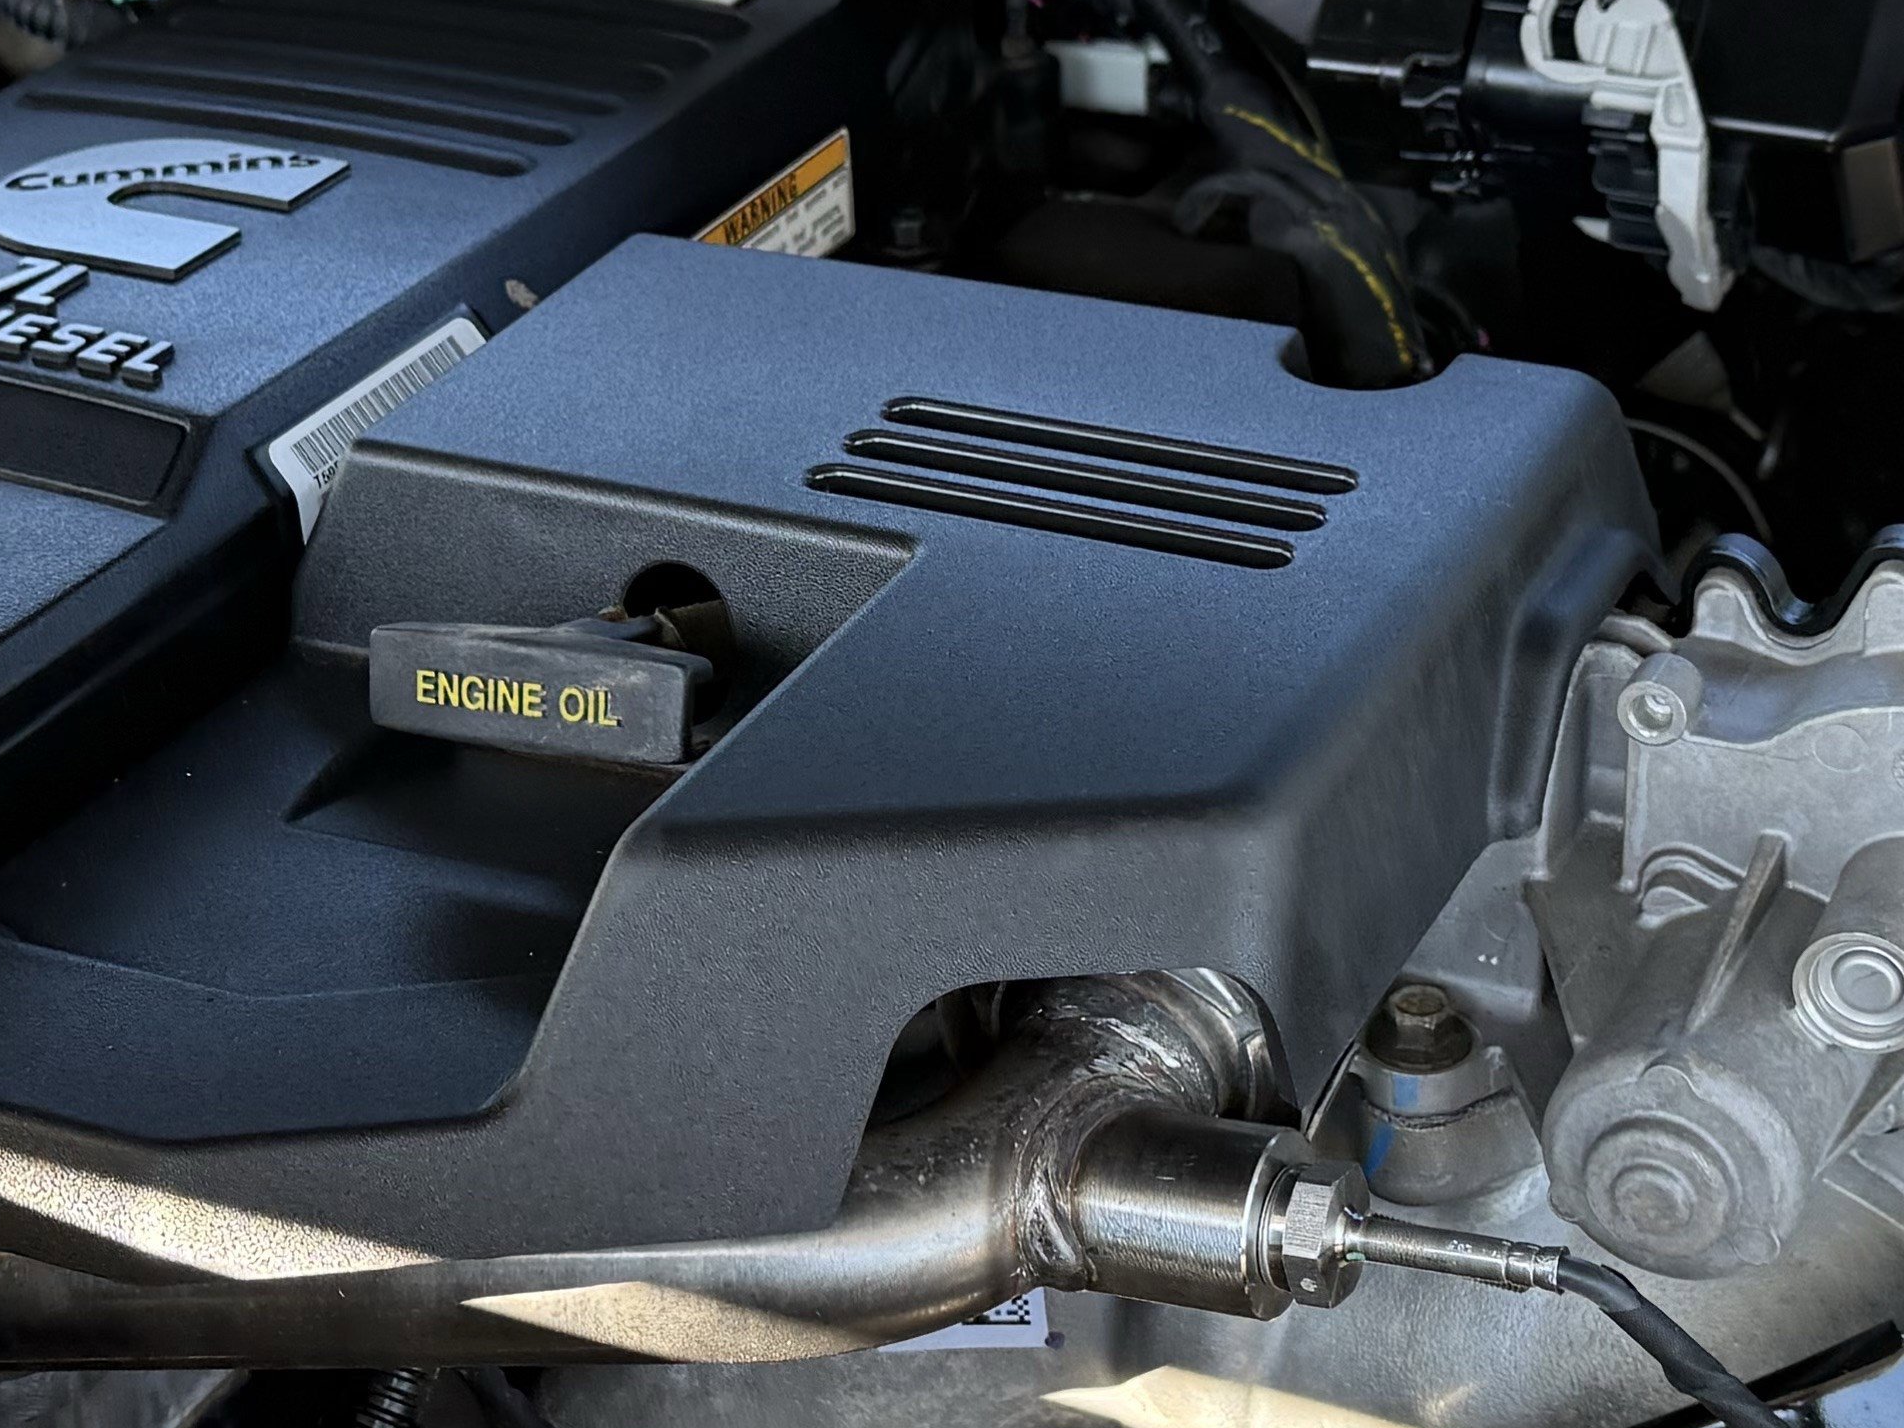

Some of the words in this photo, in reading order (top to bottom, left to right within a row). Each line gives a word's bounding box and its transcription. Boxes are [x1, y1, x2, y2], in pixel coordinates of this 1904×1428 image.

[5, 153, 322, 192] Cummins
[722, 172, 798, 246] WARNING
[415, 669, 543, 719] ENGINE
[558, 685, 622, 727] OIL
